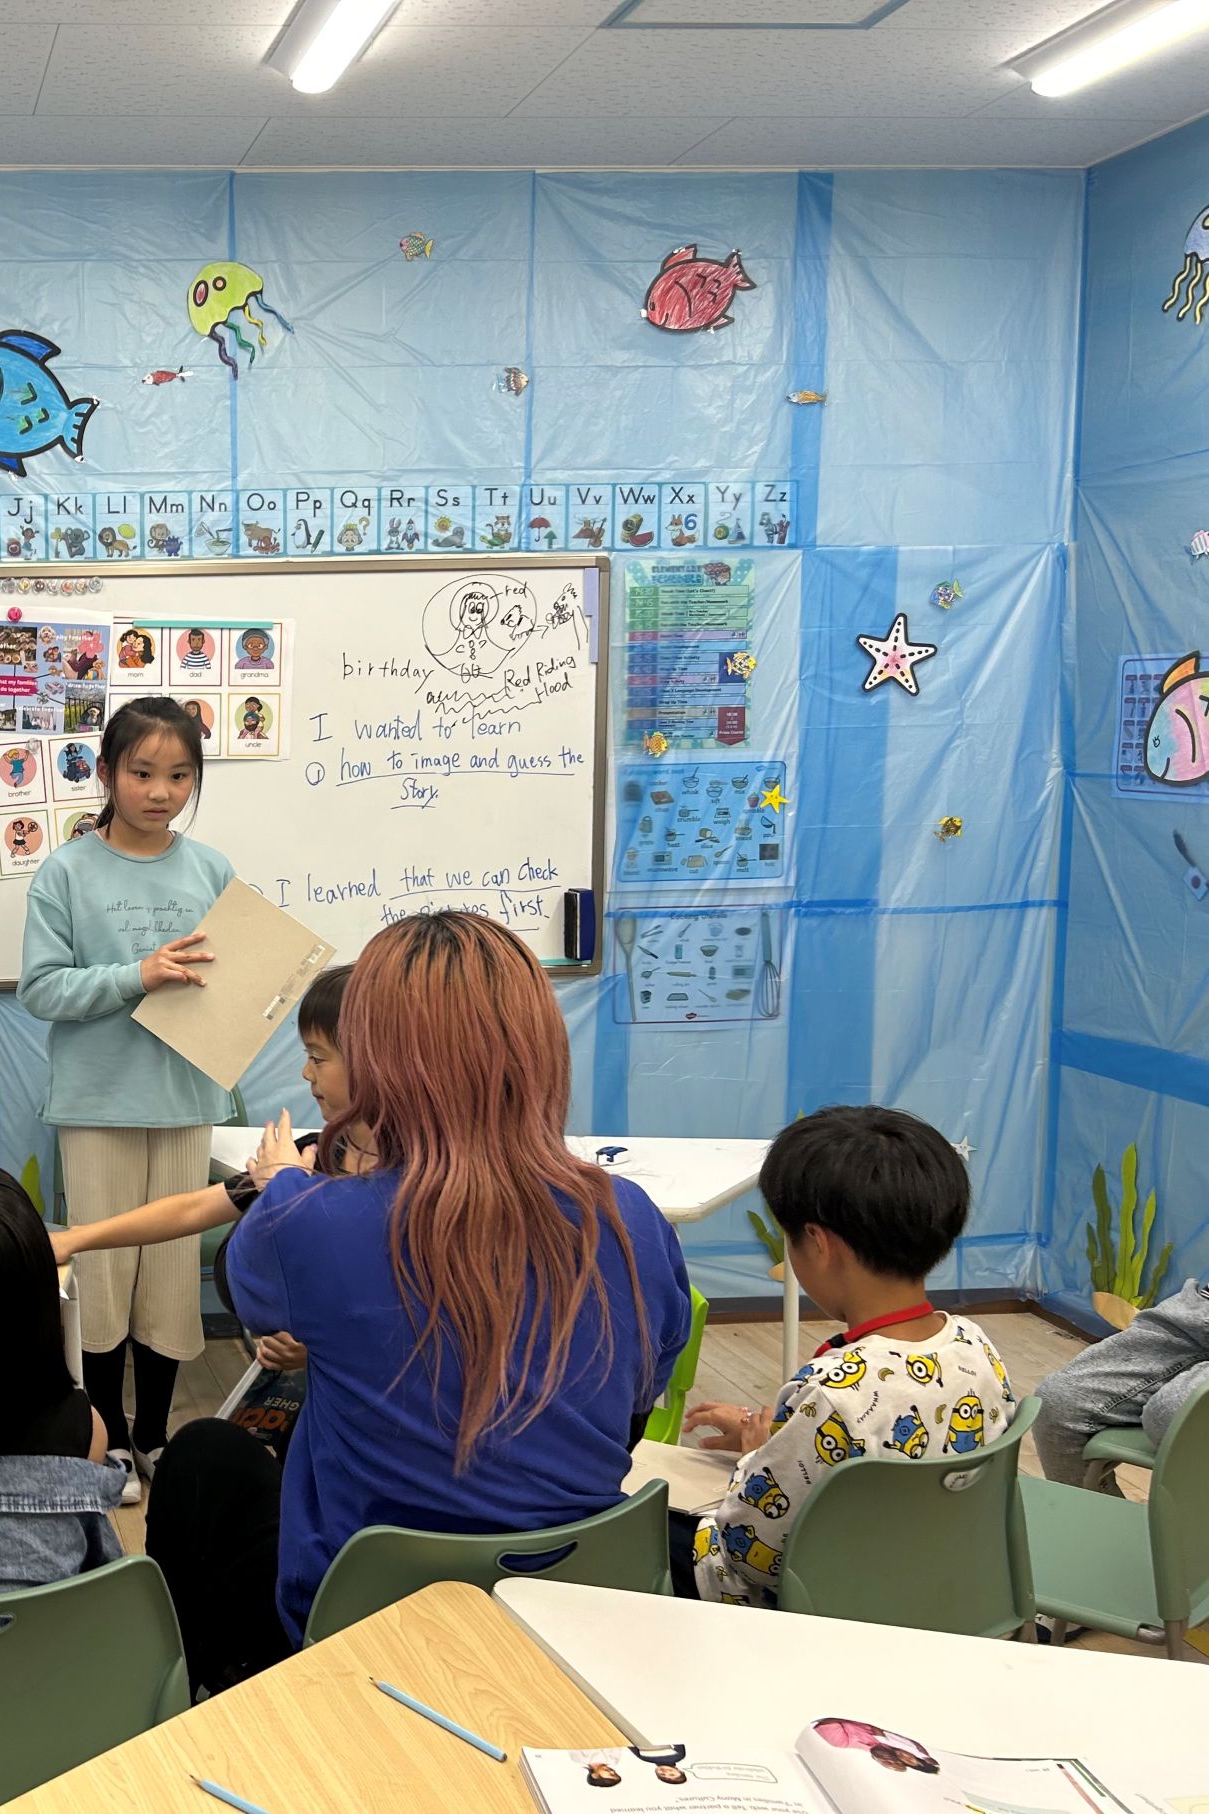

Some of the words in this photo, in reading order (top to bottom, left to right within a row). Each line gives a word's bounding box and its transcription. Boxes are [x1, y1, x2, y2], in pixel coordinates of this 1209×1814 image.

[504, 580, 528, 597] red
[68, 634, 95, 642] together
[240, 671, 269, 680] grandma
[342, 652, 435, 694] birthday
[504, 664, 531, 689] Red
[536, 656, 577, 680] Riding
[8, 686, 31, 694] together
[309, 713, 334, 742] I
[354, 709, 422, 741] wanted
[433, 719, 454, 738] to
[472, 706, 522, 739] learn
[340, 747, 372, 780] how
[386, 751, 403, 771] to
[412, 752, 461, 775] image
[469, 748, 499, 770] and
[506, 754, 552, 779] guess
[558, 745, 585, 765] the
[8, 790, 32, 798] brother
[71, 784, 87, 792] sister
[12, 858, 40, 867] daughter
[276, 878, 291, 908] I
[307, 868, 382, 904] learned
[400, 865, 435, 892] that
[446, 867, 473, 889] we
[481, 866, 510, 888] can
